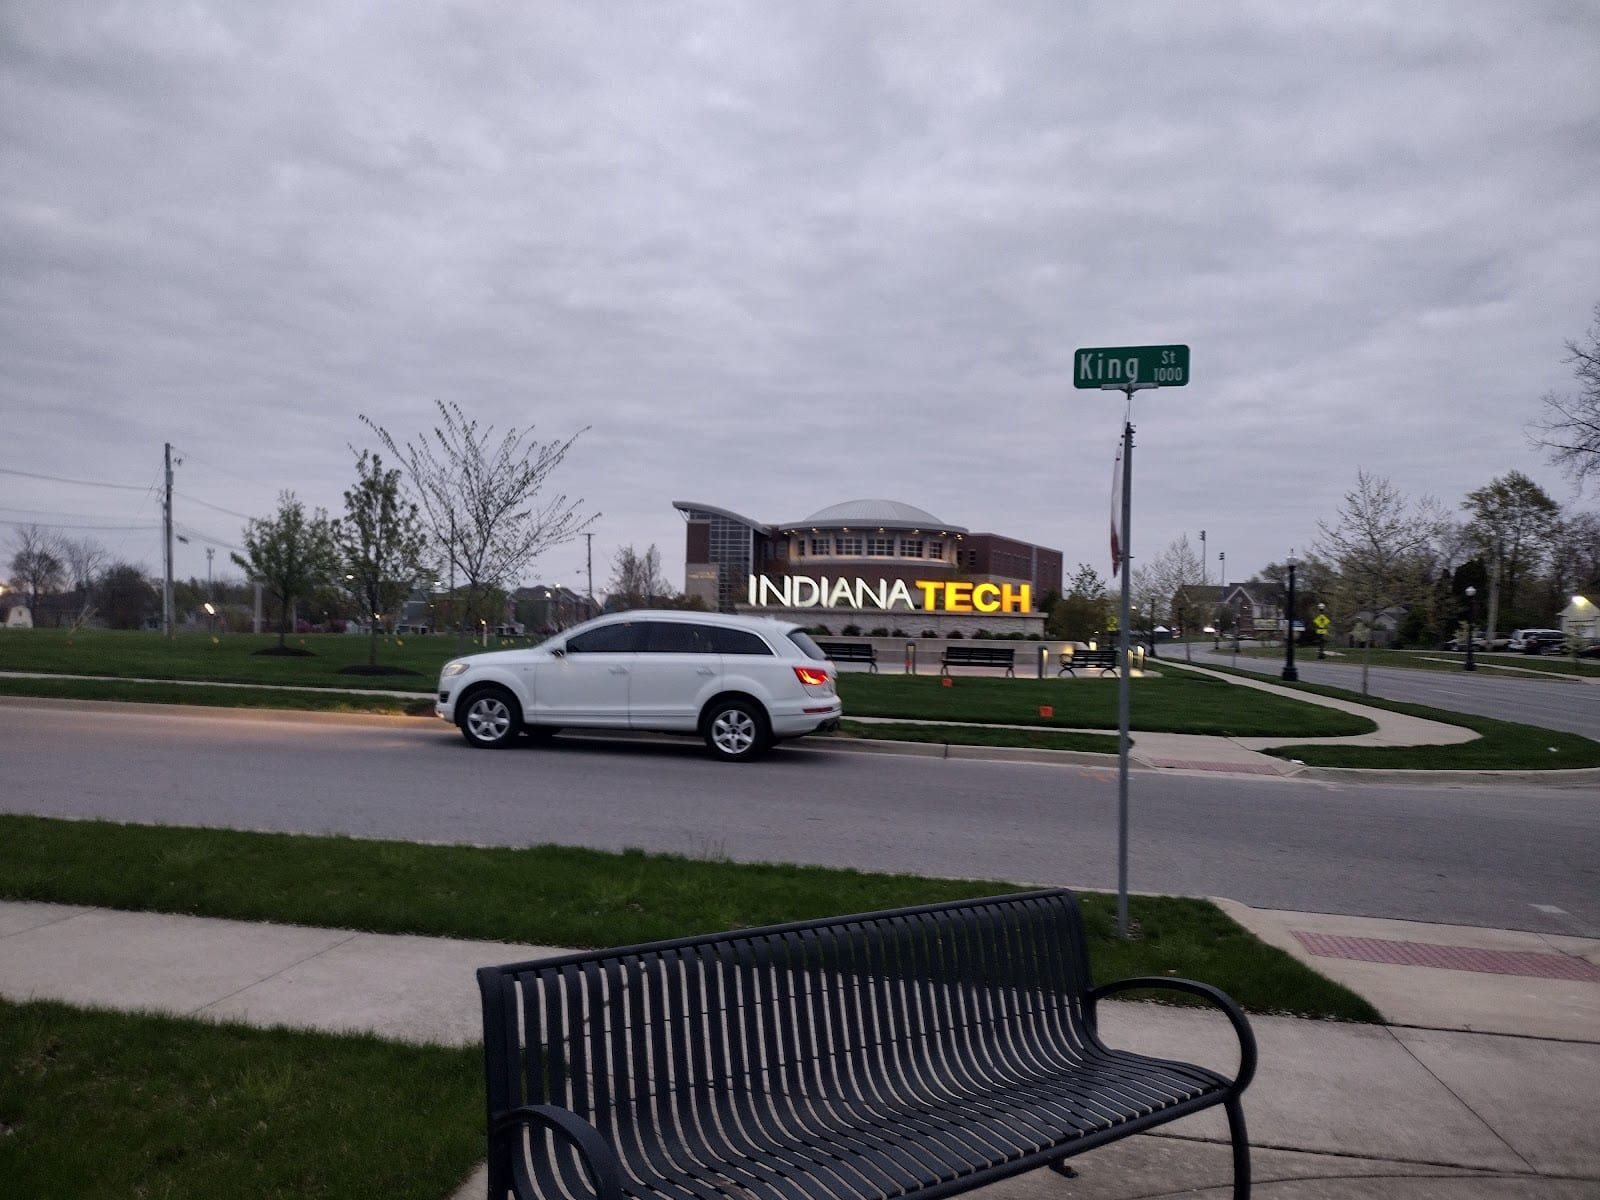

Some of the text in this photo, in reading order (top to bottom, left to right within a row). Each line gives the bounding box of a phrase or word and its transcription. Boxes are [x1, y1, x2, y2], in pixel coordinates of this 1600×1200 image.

[1080, 350, 1176, 384] King St
[1154, 367, 1183, 381] 1000
[748, 574, 1031, 613] INDIANA TECH
